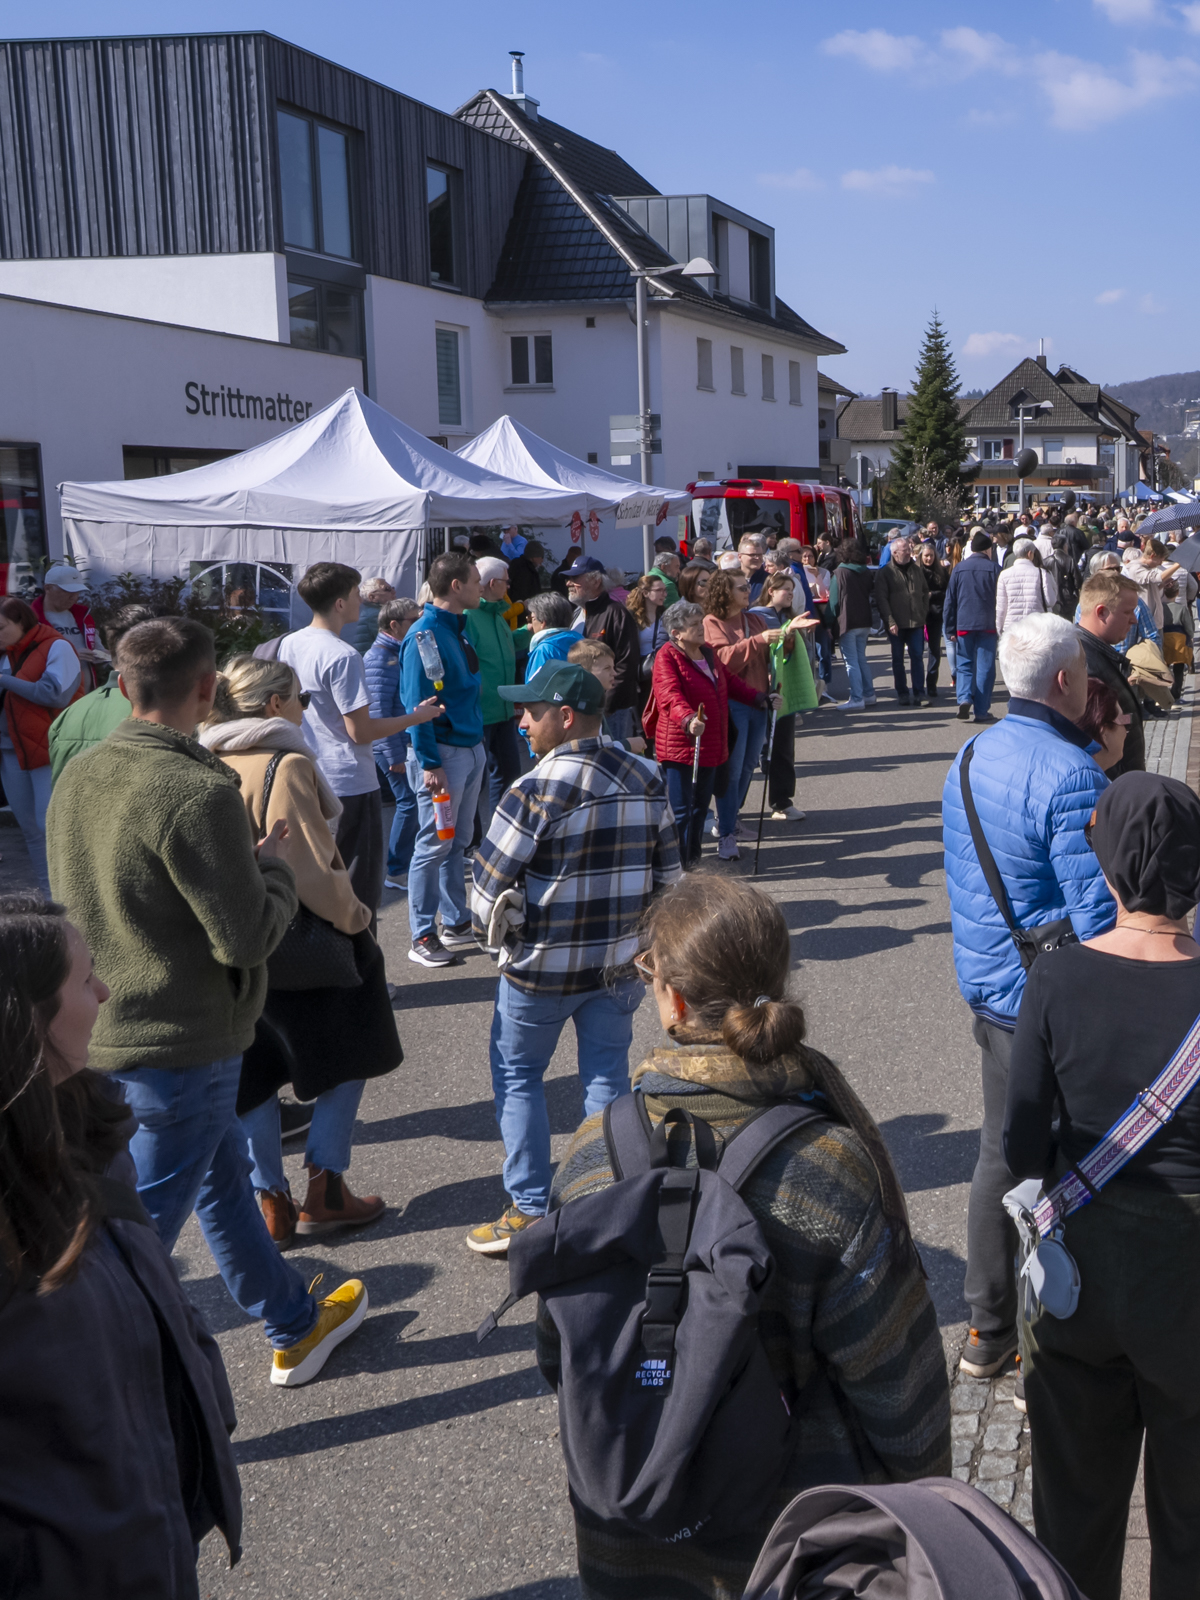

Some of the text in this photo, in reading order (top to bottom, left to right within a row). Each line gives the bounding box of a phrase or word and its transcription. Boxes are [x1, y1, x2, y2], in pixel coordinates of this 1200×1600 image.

[185, 381, 313, 423] Strittmatter
[635, 1369, 672, 1379] RECYCLE
[641, 1378, 664, 1386] BAGS
